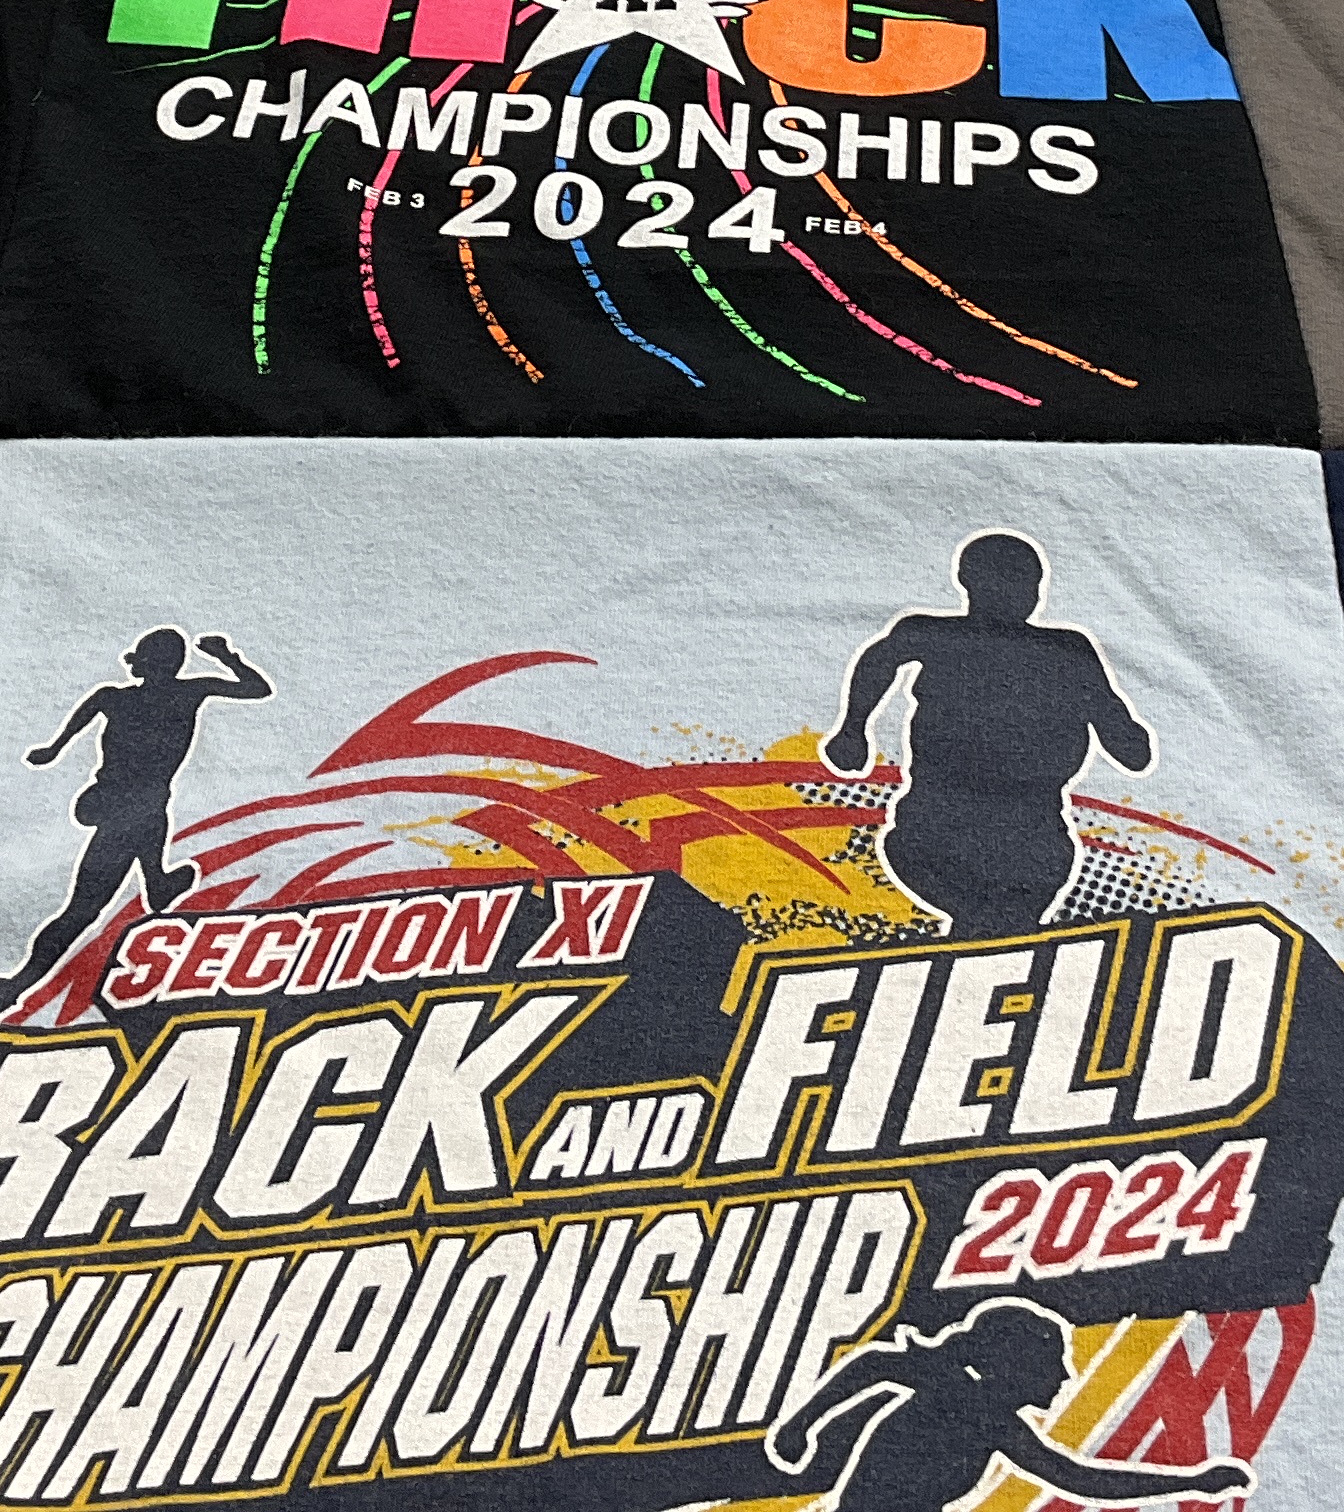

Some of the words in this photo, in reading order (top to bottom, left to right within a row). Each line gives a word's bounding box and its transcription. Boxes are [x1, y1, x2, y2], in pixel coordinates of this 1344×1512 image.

[155, 68, 1100, 196] CHAMPIONSHIPS
[346, 177, 401, 206] FEB
[409, 192, 425, 209] 3
[438, 164, 786, 254] 2024
[804, 216, 862, 235] FEB
[871, 221, 887, 235] 4
[102, 883, 522, 1010] SECTION
[533, 875, 655, 967] XI
[530, 1092, 705, 1180] AND
[716, 922, 1283, 1164] FIELD
[935, 1139, 1269, 1290] 2024
